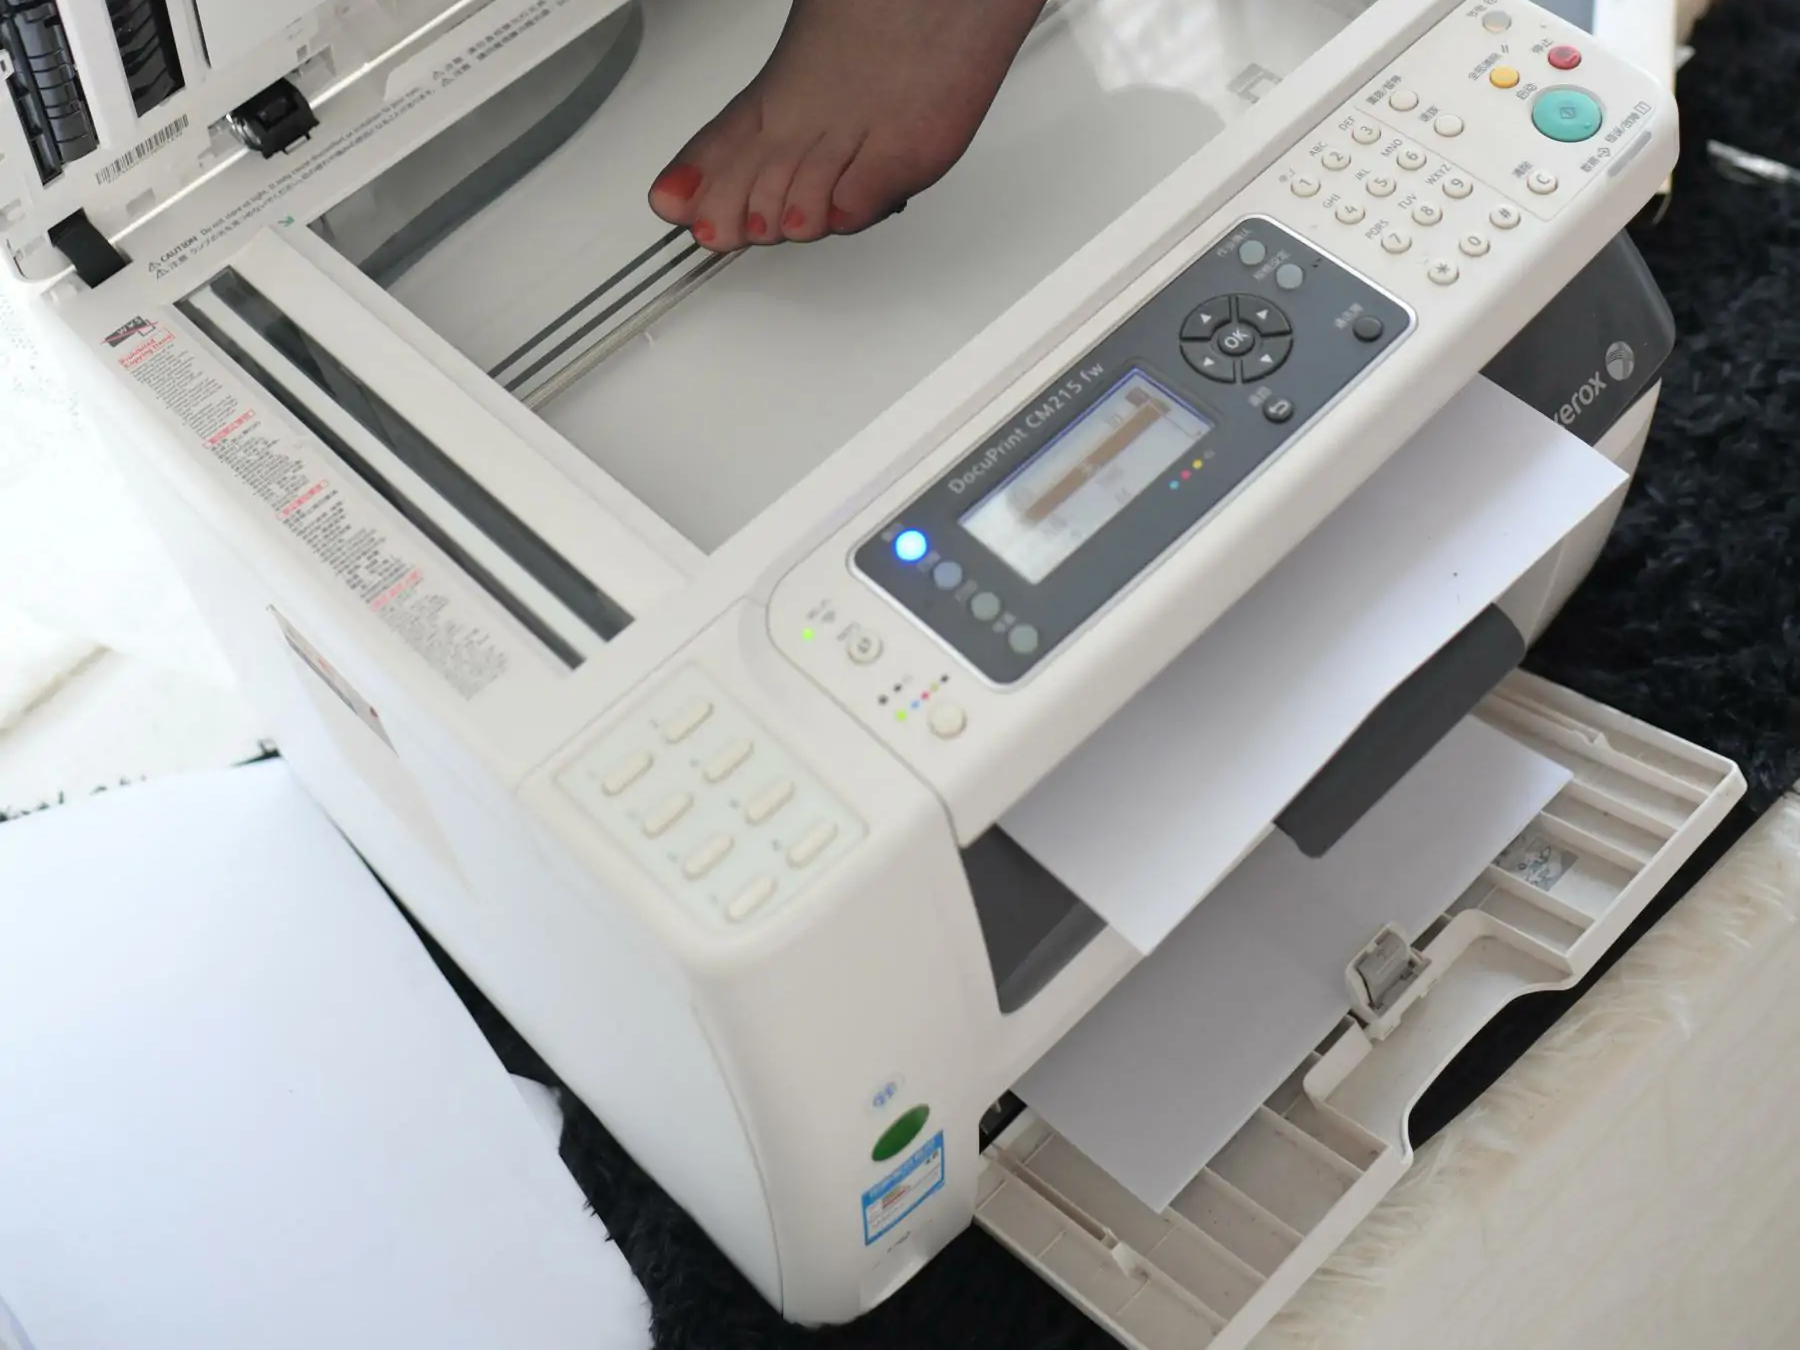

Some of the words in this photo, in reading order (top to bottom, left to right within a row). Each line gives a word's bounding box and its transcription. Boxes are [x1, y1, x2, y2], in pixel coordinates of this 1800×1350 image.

[1515, 82, 1538, 100] 启动
[1338, 115, 1355, 131] DEF
[1360, 126, 1373, 137] 3
[1308, 141, 1329, 158] ABC
[1380, 138, 1404, 158] MNO
[1330, 150, 1344, 163] 2
[1405, 150, 1419, 162] 6
[1424, 163, 1452, 186] WXYZ
[1536, 173, 1551, 185] C
[1299, 177, 1313, 187] 1
[1373, 176, 1388, 188] 5
[1450, 177, 1465, 189] 9
[1398, 193, 1418, 210] TUV
[1344, 205, 1358, 215] 4
[1421, 205, 1434, 217] 8
[1498, 206, 1512, 219] #
[1364, 218, 1389, 240] PQRS
[1389, 232, 1402, 244] 7
[1467, 235, 1482, 247] 0
[159, 234, 198, 263] CAUTION
[1224, 328, 1249, 349] OK
[948, 427, 1028, 494] DocuPrint
[1025, 380, 1083, 428] CM215
[1079, 362, 1105, 383] fw
